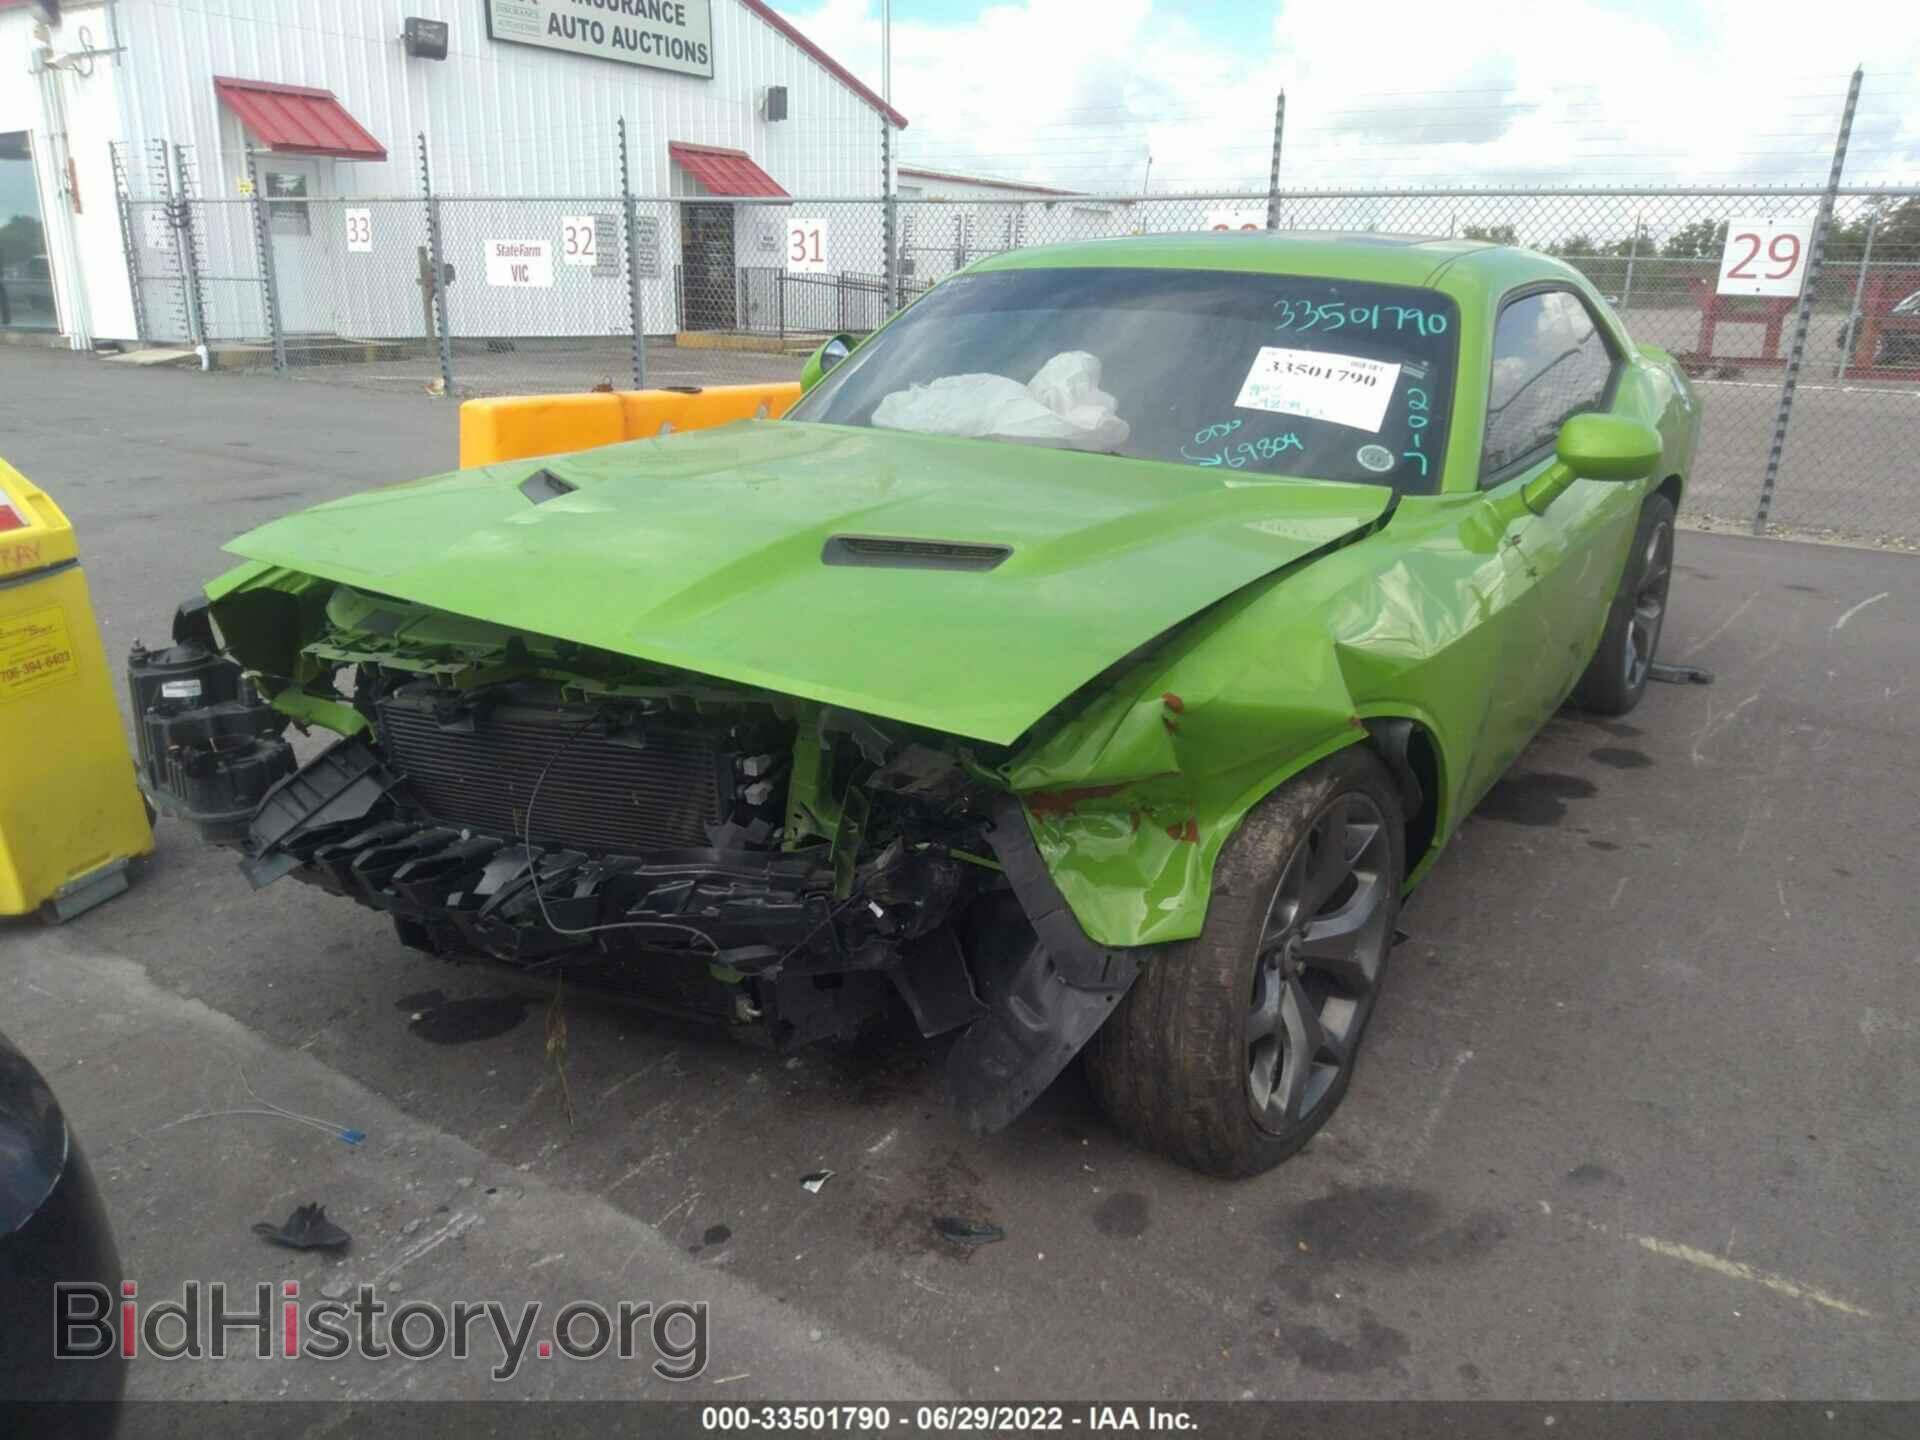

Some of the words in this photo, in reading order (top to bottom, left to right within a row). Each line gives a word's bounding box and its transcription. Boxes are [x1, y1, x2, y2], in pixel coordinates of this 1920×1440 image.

[547, 12, 605, 45] AUTO
[612, 25, 708, 65] AUCTIONS
[347, 217, 370, 242] 33
[565, 226, 594, 255] 32
[791, 229, 825, 262] 31
[1727, 233, 1800, 279] 29
[511, 264, 529, 282] VIC
[1273, 300, 1447, 336] 33501790
[1264, 361, 1377, 387] 33501790
[1224, 432, 1304, 468] 69804
